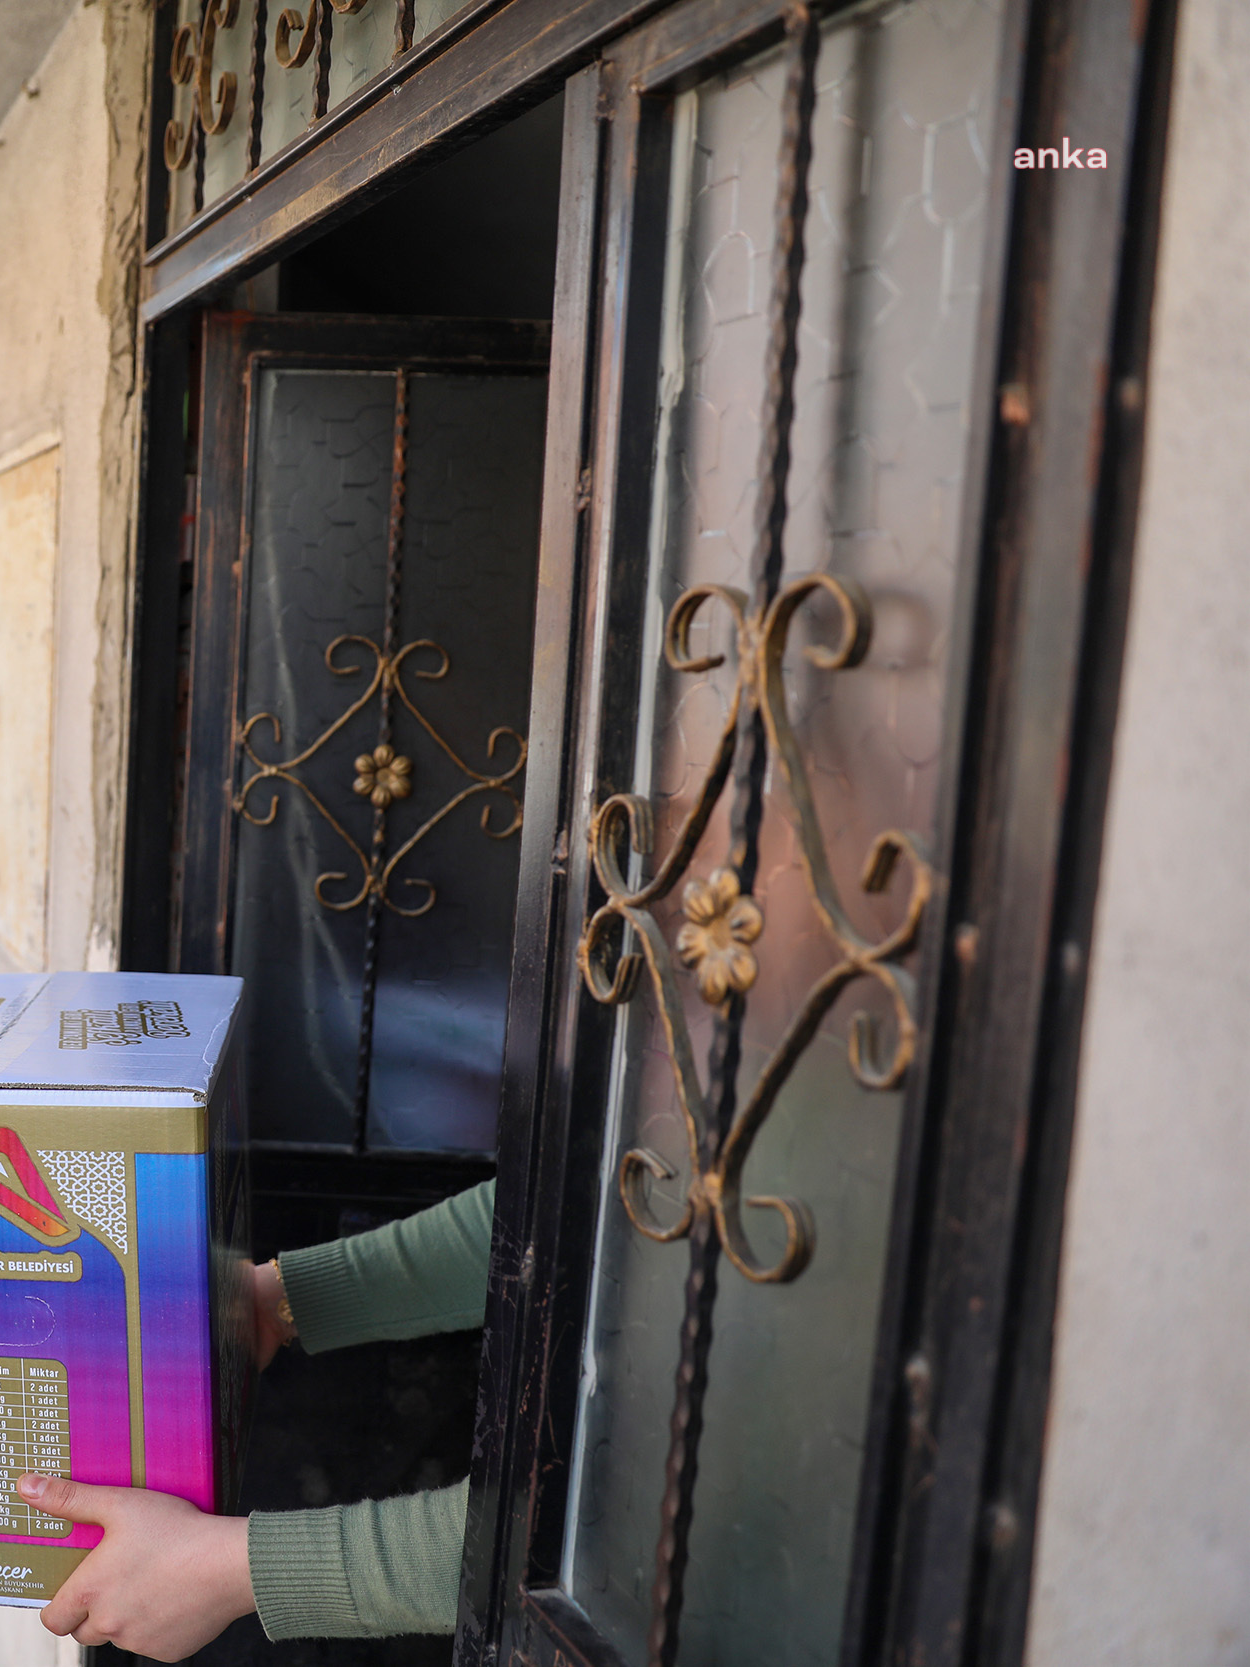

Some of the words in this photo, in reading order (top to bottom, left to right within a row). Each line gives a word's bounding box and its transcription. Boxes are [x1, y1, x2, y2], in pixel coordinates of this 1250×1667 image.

[8, 1259, 74, 1273] BELEDİYESİ
[30, 1368, 59, 1378] Miktar
[30, 1383, 35, 1391] 2
[39, 1384, 58, 1393] adet
[31, 1396, 35, 1404] 1
[39, 1396, 58, 1405] adet
[32, 1408, 35, 1416] 1
[39, 1409, 58, 1418] adet
[32, 1421, 37, 1429] 2
[40, 1422, 59, 1430] adet
[33, 1433, 37, 1441] 1
[40, 1434, 59, 1443] adet
[33, 1445, 38, 1454] 5
[41, 1446, 61, 1455] adet
[33, 1458, 37, 1466] 1
[41, 1459, 60, 1468] adet
[10, 1483, 15, 1491] g
[0, 1493, 9, 1503] kg
[0, 1505, 10, 1515] kg
[12, 1520, 17, 1528] g
[36, 1520, 41, 1528] 2
[44, 1521, 64, 1530] adet
